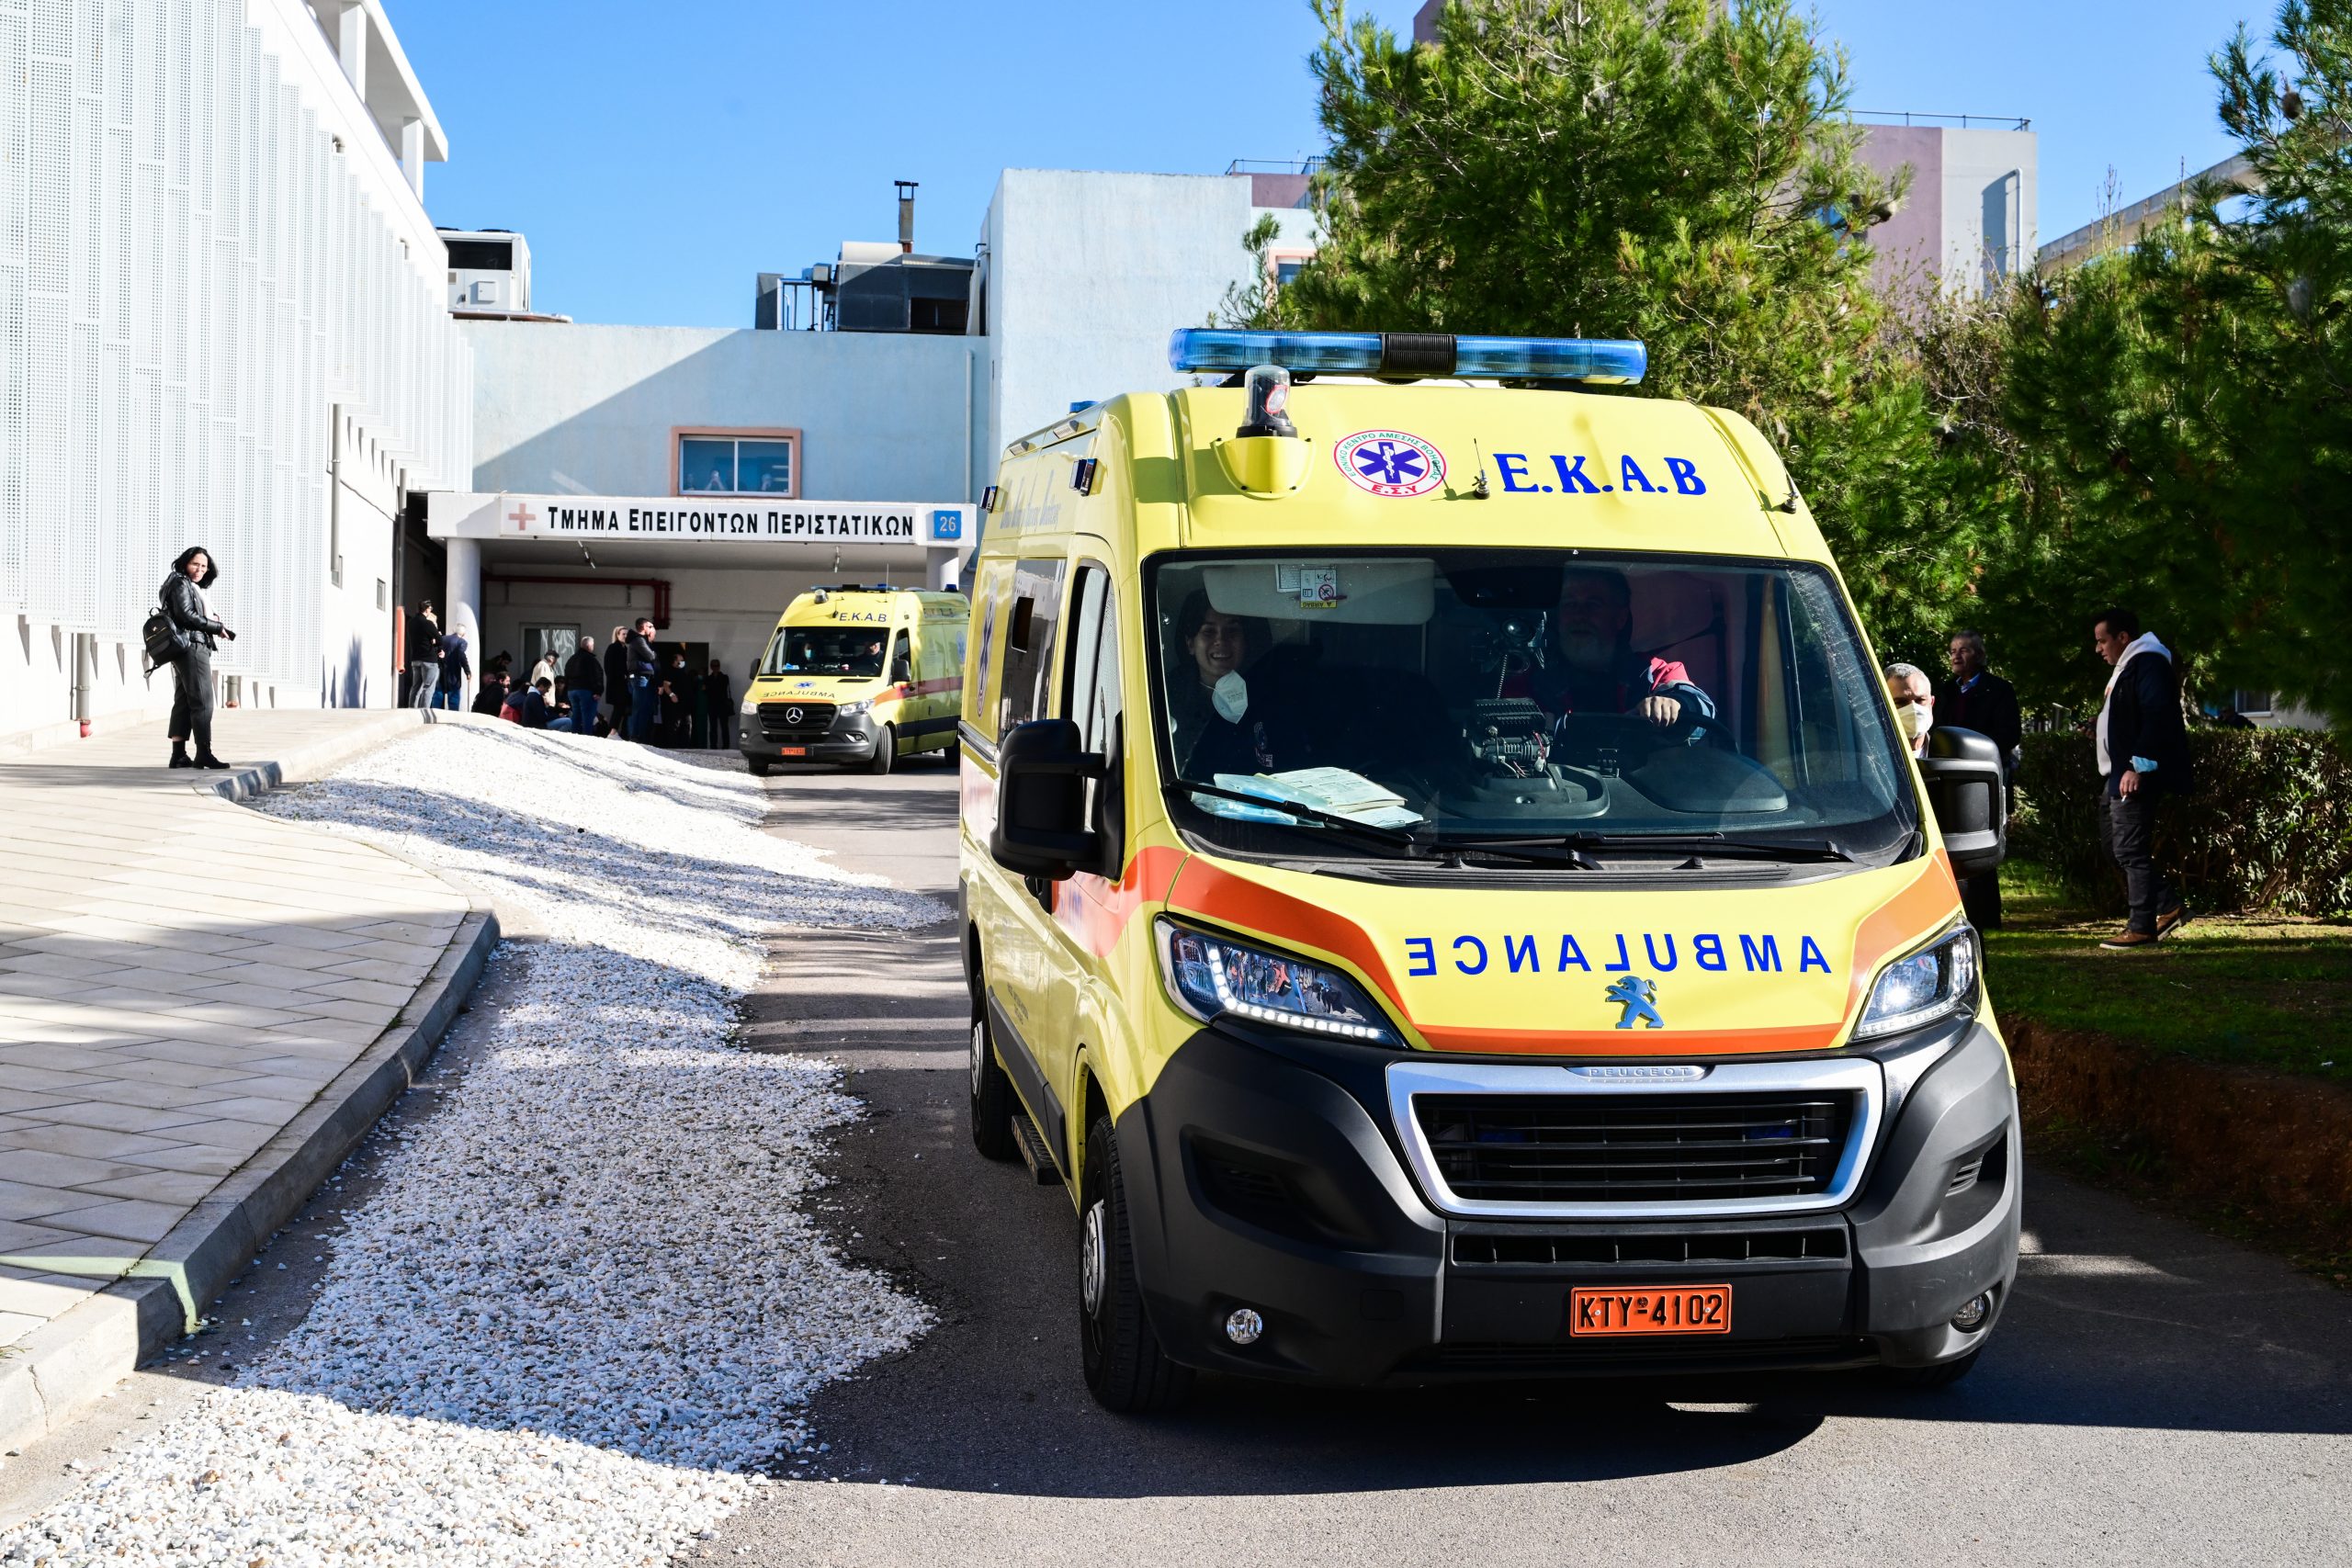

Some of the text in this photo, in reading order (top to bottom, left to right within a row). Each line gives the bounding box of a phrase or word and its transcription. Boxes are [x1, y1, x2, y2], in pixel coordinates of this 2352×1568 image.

[1343, 433, 1376, 452] ΚΕΝΤΡΟ
[1378, 432, 1421, 446] ΑΜΕΣΗΣ
[1493, 453, 1706, 496] Ε.Κ.Α.Β
[548, 506, 913, 536] ΤΜΗΜΑ ΕΠΕΙΓΟΝΤΩΝ ΠΕΡΙΣΤΑΤΙΚΩΝ
[940, 515, 956, 532] 26
[1589, 1067, 1689, 1077] PEUGEOT
